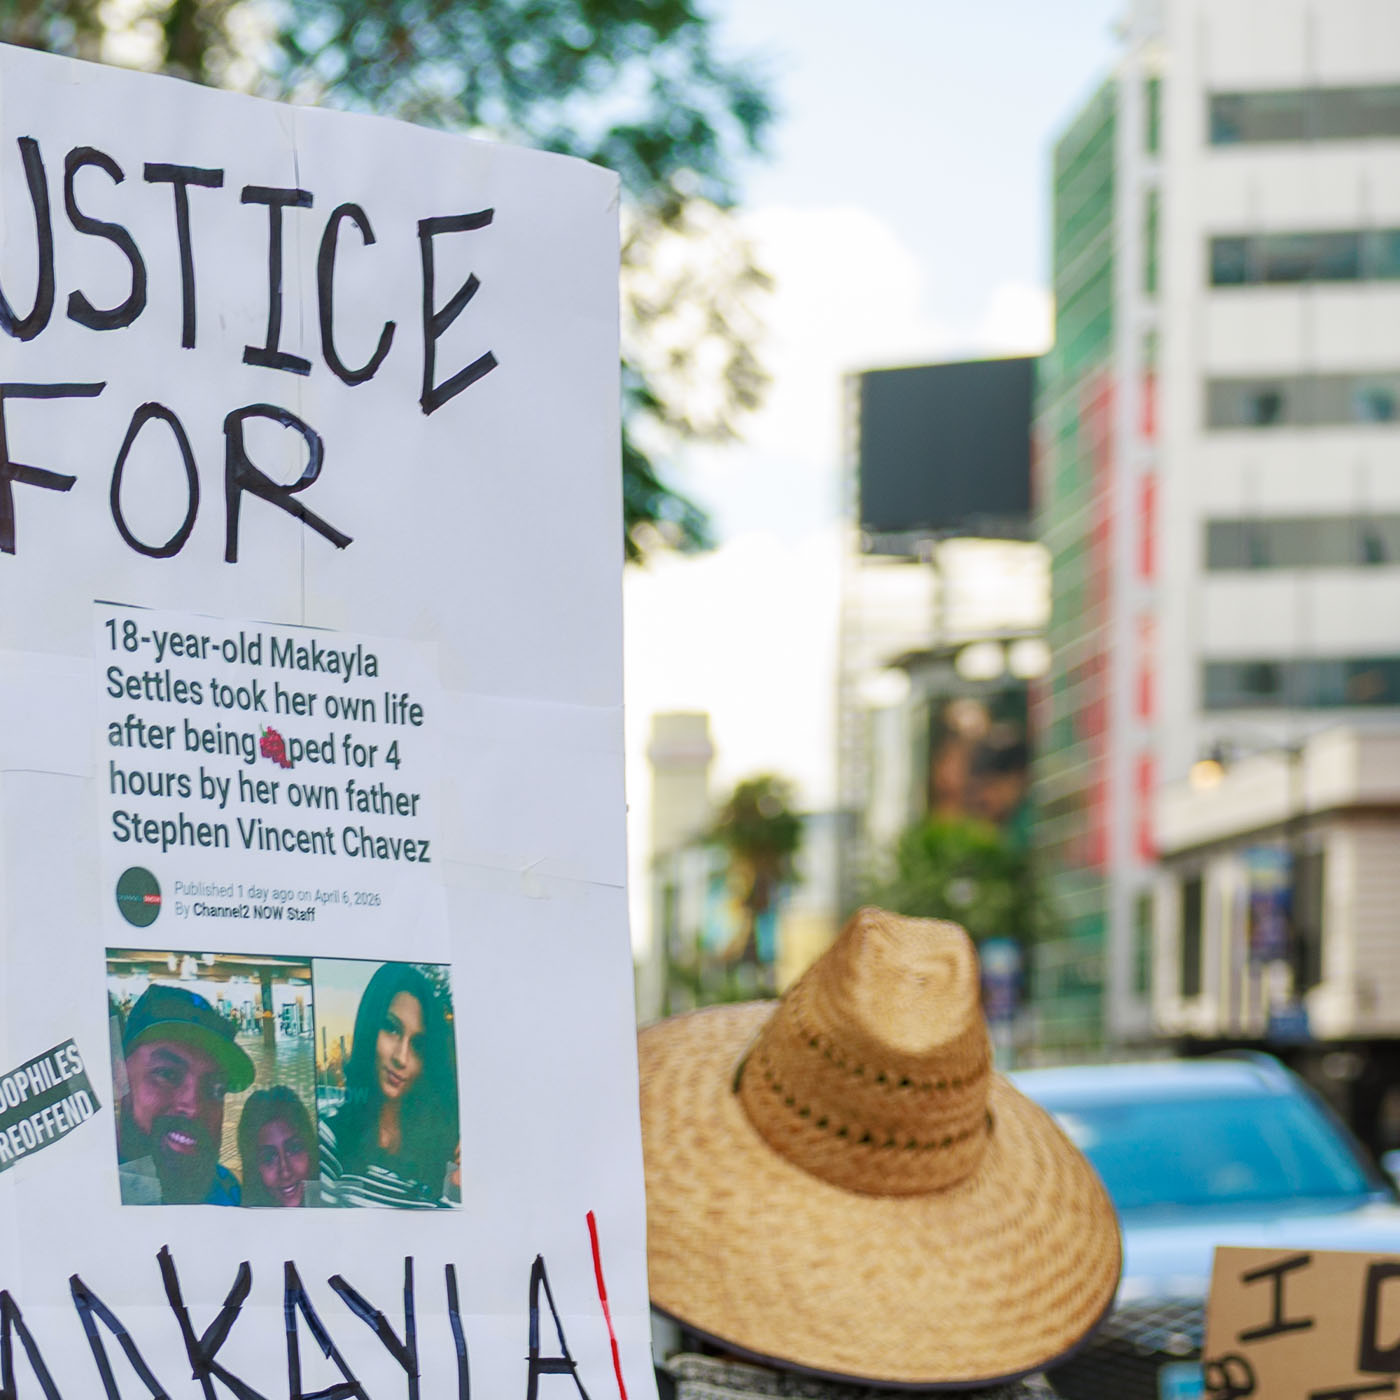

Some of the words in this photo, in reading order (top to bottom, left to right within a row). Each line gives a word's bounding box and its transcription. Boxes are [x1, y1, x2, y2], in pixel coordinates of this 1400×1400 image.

[105, 618, 263, 664] 18-year-old
[271, 636, 379, 684] Makayla
[106, 665, 203, 706] Settles
[210, 679, 269, 714] took
[275, 681, 318, 717] her
[325, 694, 377, 724] own
[384, 691, 425, 728] life
[108, 714, 176, 752] after
[184, 718, 257, 764] being
[342, 733, 379, 768] for
[386, 740, 402, 770] 4
[109, 760, 192, 799] hours
[200, 766, 231, 809] by
[239, 770, 280, 805] her
[287, 783, 340, 811] own
[346, 779, 421, 817] father
[112, 810, 230, 853] Stephen
[237, 817, 336, 856] Vincent
[342, 826, 432, 863] Chavez
[175, 881, 234, 899] Published
[237, 884, 244, 898] 1
[248, 884, 269, 904] day
[272, 888, 295, 905] ago
[298, 890, 311, 902] on
[314, 889, 341, 905] April
[175, 901, 191, 918] By
[193, 902, 251, 919] Channel2
[253, 904, 283, 920] NOW
[286, 905, 316, 922] Staff
[1236, 1254, 1314, 1343] I
